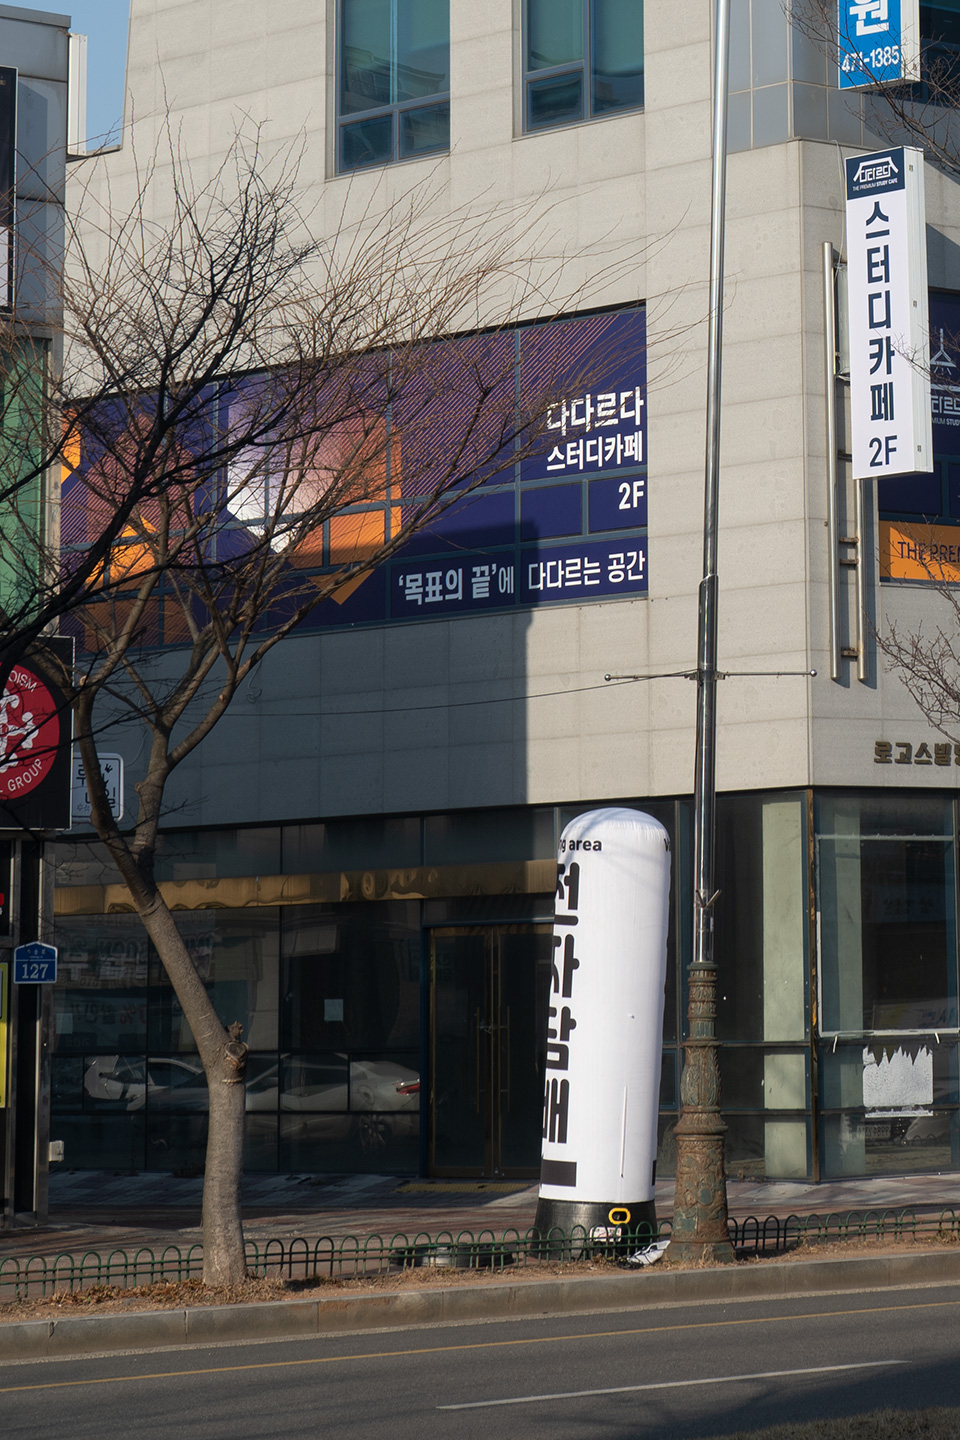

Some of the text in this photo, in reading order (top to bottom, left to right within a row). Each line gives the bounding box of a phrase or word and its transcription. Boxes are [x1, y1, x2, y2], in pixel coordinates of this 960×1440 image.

[841, 45, 899, 76] 471-1385
[865, 201, 895, 422] 스터디카페
[546, 386, 644, 435] 다다르다
[546, 432, 644, 472] 스터디카페
[869, 435, 898, 467] 2F
[618, 481, 644, 510] 2F
[898, 541, 926, 560] THE
[527, 556, 600, 591] 다다르는
[607, 550, 645, 584] 공간
[7, 759, 42, 792] GROUP
[569, 840, 602, 852] area
[22, 963, 48, 979] 127
